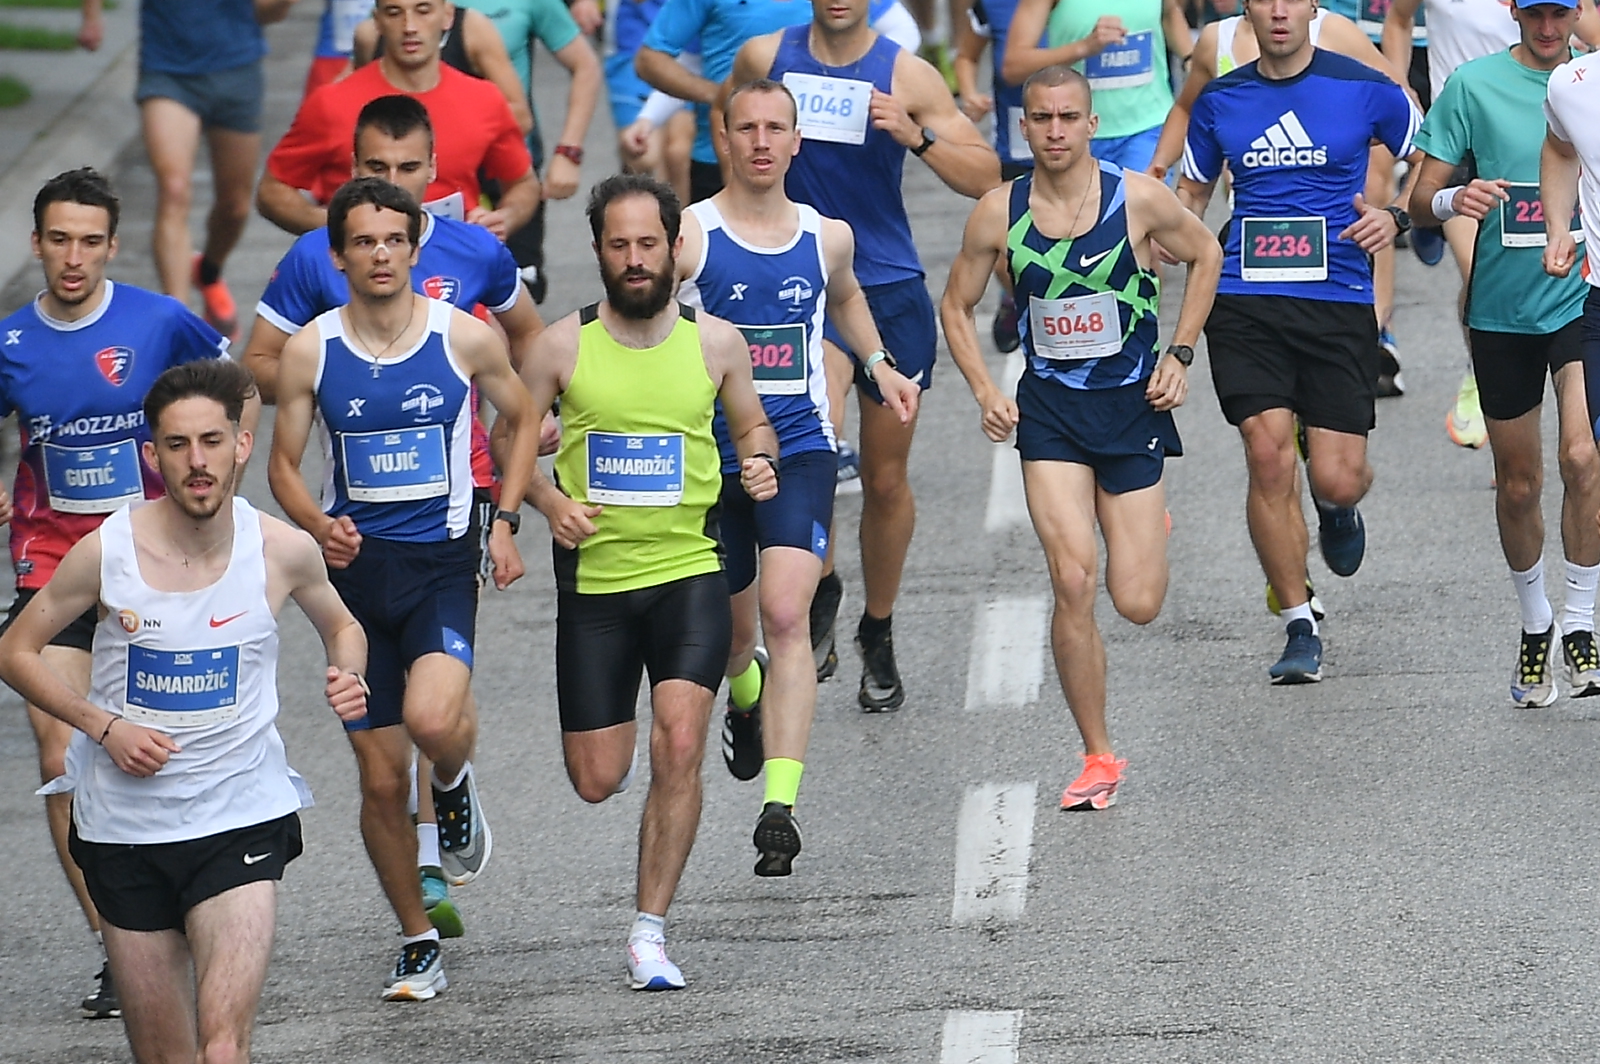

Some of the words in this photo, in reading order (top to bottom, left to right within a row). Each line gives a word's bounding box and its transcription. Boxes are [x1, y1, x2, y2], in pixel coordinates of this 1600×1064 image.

[797, 92, 853, 117] 1048
[1242, 145, 1328, 167] adidas
[1254, 235, 1312, 257] 2236
[1043, 311, 1105, 336] 5048
[749, 343, 794, 368] 302
[58, 410, 145, 437] MOZZART
[369, 446, 420, 474] VUJIĆ
[595, 454, 676, 476] SAMARDŽIĆ
[65, 461, 116, 488] GUTIĆ
[143, 619, 161, 628] NN
[136, 667, 230, 694] SAMARDŽIĆ
